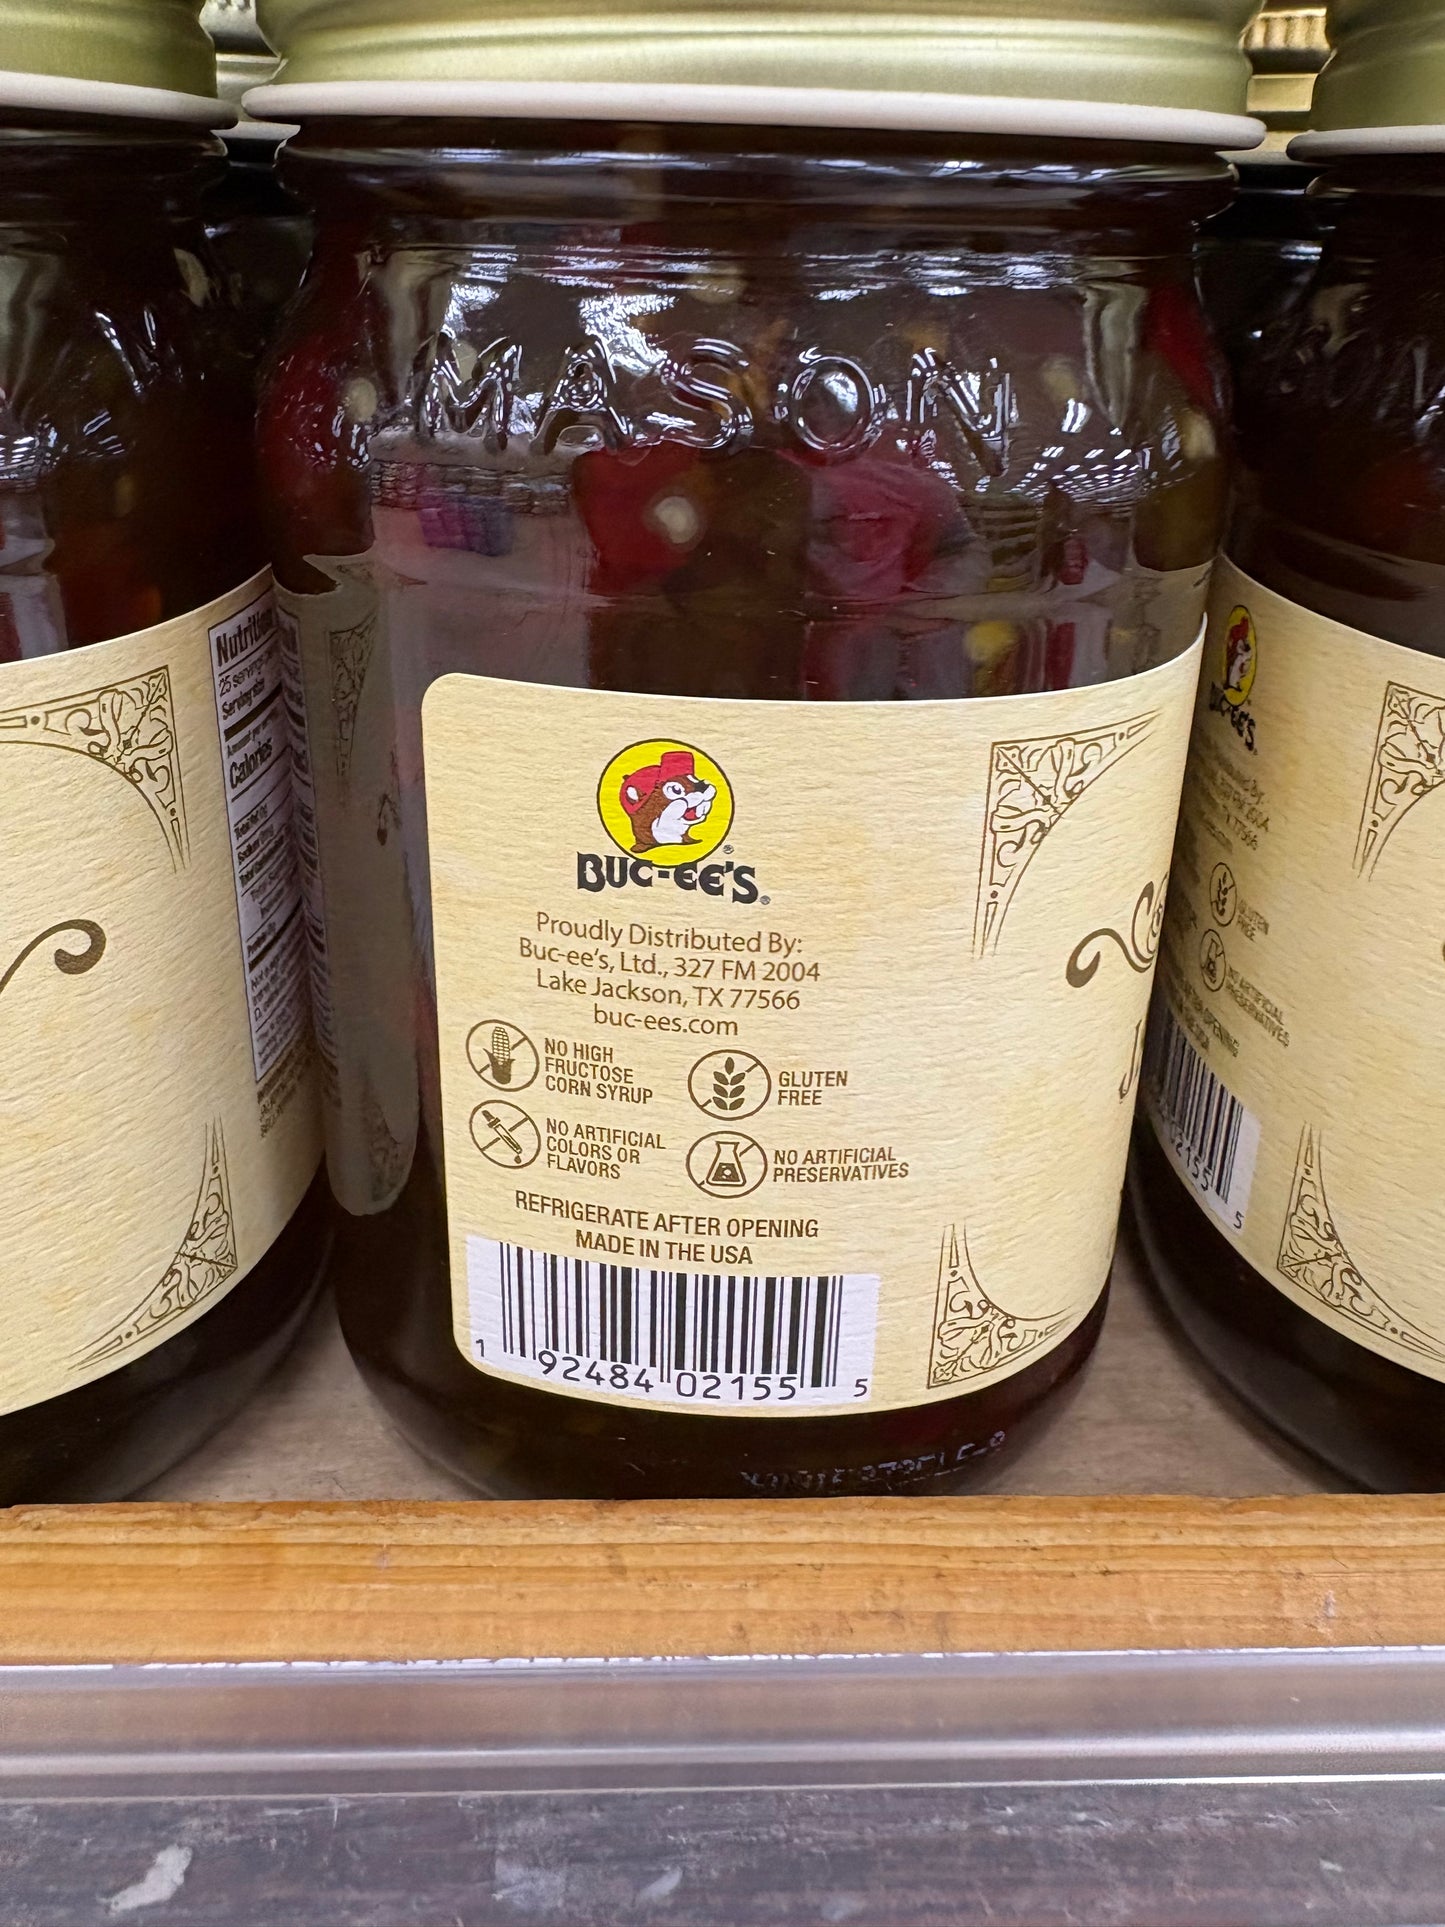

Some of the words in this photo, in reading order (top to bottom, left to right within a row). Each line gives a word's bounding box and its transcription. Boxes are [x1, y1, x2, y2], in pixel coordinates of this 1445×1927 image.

[415, 329, 1012, 472] MASON
[577, 851, 759, 904] BUC-EE'S
[536, 911, 623, 947] Proudly
[629, 923, 761, 953] Distributed
[768, 932, 803, 958] By:
[519, 937, 615, 973] Buc-ee's,
[620, 952, 669, 979] Ltd.,
[674, 957, 715, 979] 327
[721, 960, 756, 981] FM
[761, 961, 820, 982] 2004
[536, 967, 587, 995] Lake
[591, 977, 688, 1008] Jackson,
[692, 985, 724, 1008] TX
[730, 989, 801, 1010] 77566
[594, 1003, 738, 1036] buc-ees.com
[544, 1037, 568, 1056] NO
[573, 1042, 614, 1064] HIGH
[544, 1056, 634, 1084] FRUCTOSE
[778, 1070, 848, 1088] GLUTEN
[545, 1075, 591, 1097] CORN
[596, 1083, 653, 1104] SYRUP
[777, 1089, 823, 1106] FREE
[546, 1117, 569, 1136] NO
[573, 1123, 667, 1150] ARTIFICIAL
[546, 1136, 612, 1161] COLORS
[617, 1147, 640, 1164] OR
[547, 1153, 621, 1180] FLAVORS
[773, 1149, 798, 1165] NO
[802, 1146, 897, 1165] ARTIFICIAL
[772, 1162, 909, 1183] PRESERVATIVES
[515, 1189, 649, 1231] REFRIGERATE
[653, 1212, 721, 1237] AFTER
[726, 1218, 819, 1238] OPENING
[575, 1229, 634, 1257] MADE
[640, 1238, 660, 1259] IN
[664, 1241, 705, 1263] THE
[711, 1245, 753, 1265] USA
[476, 1338, 486, 1358] 1
[537, 1349, 655, 1393] 92484
[676, 1371, 797, 1401] 02155
[853, 1377, 869, 1397] 5
